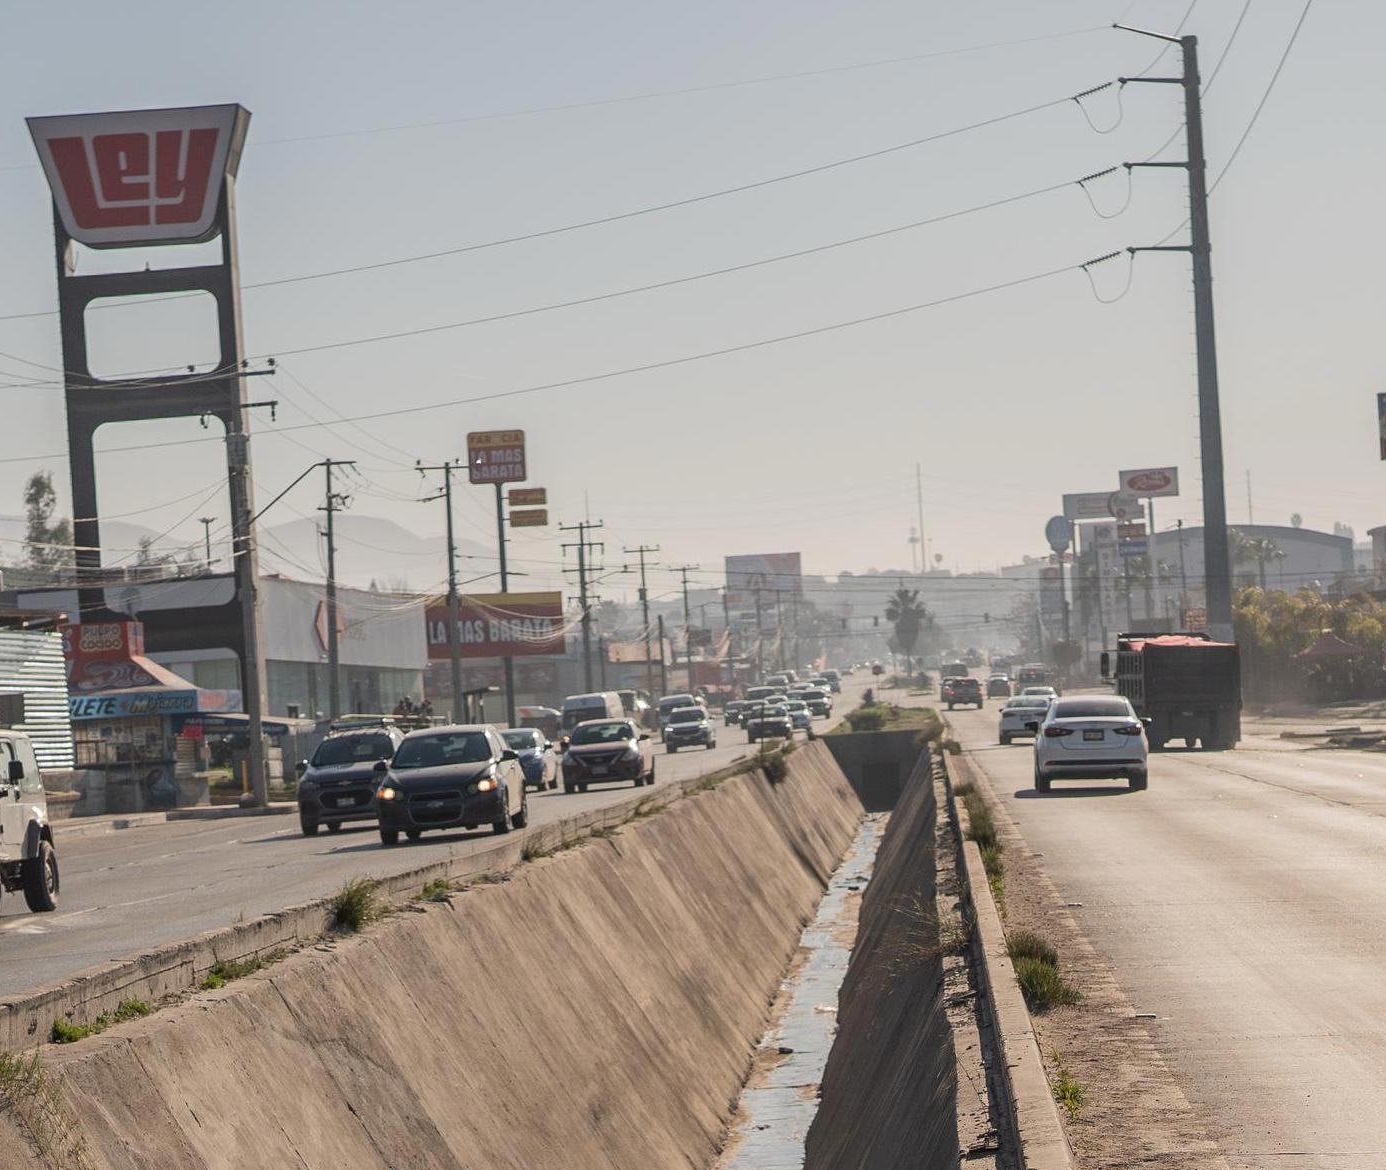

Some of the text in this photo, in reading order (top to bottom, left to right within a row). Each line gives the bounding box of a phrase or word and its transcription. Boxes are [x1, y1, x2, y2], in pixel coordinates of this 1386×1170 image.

[491, 449, 522, 463] MAS
[429, 621, 446, 644] LA
[489, 618, 552, 642] BARATA
[81, 639, 121, 650] COCIDO
